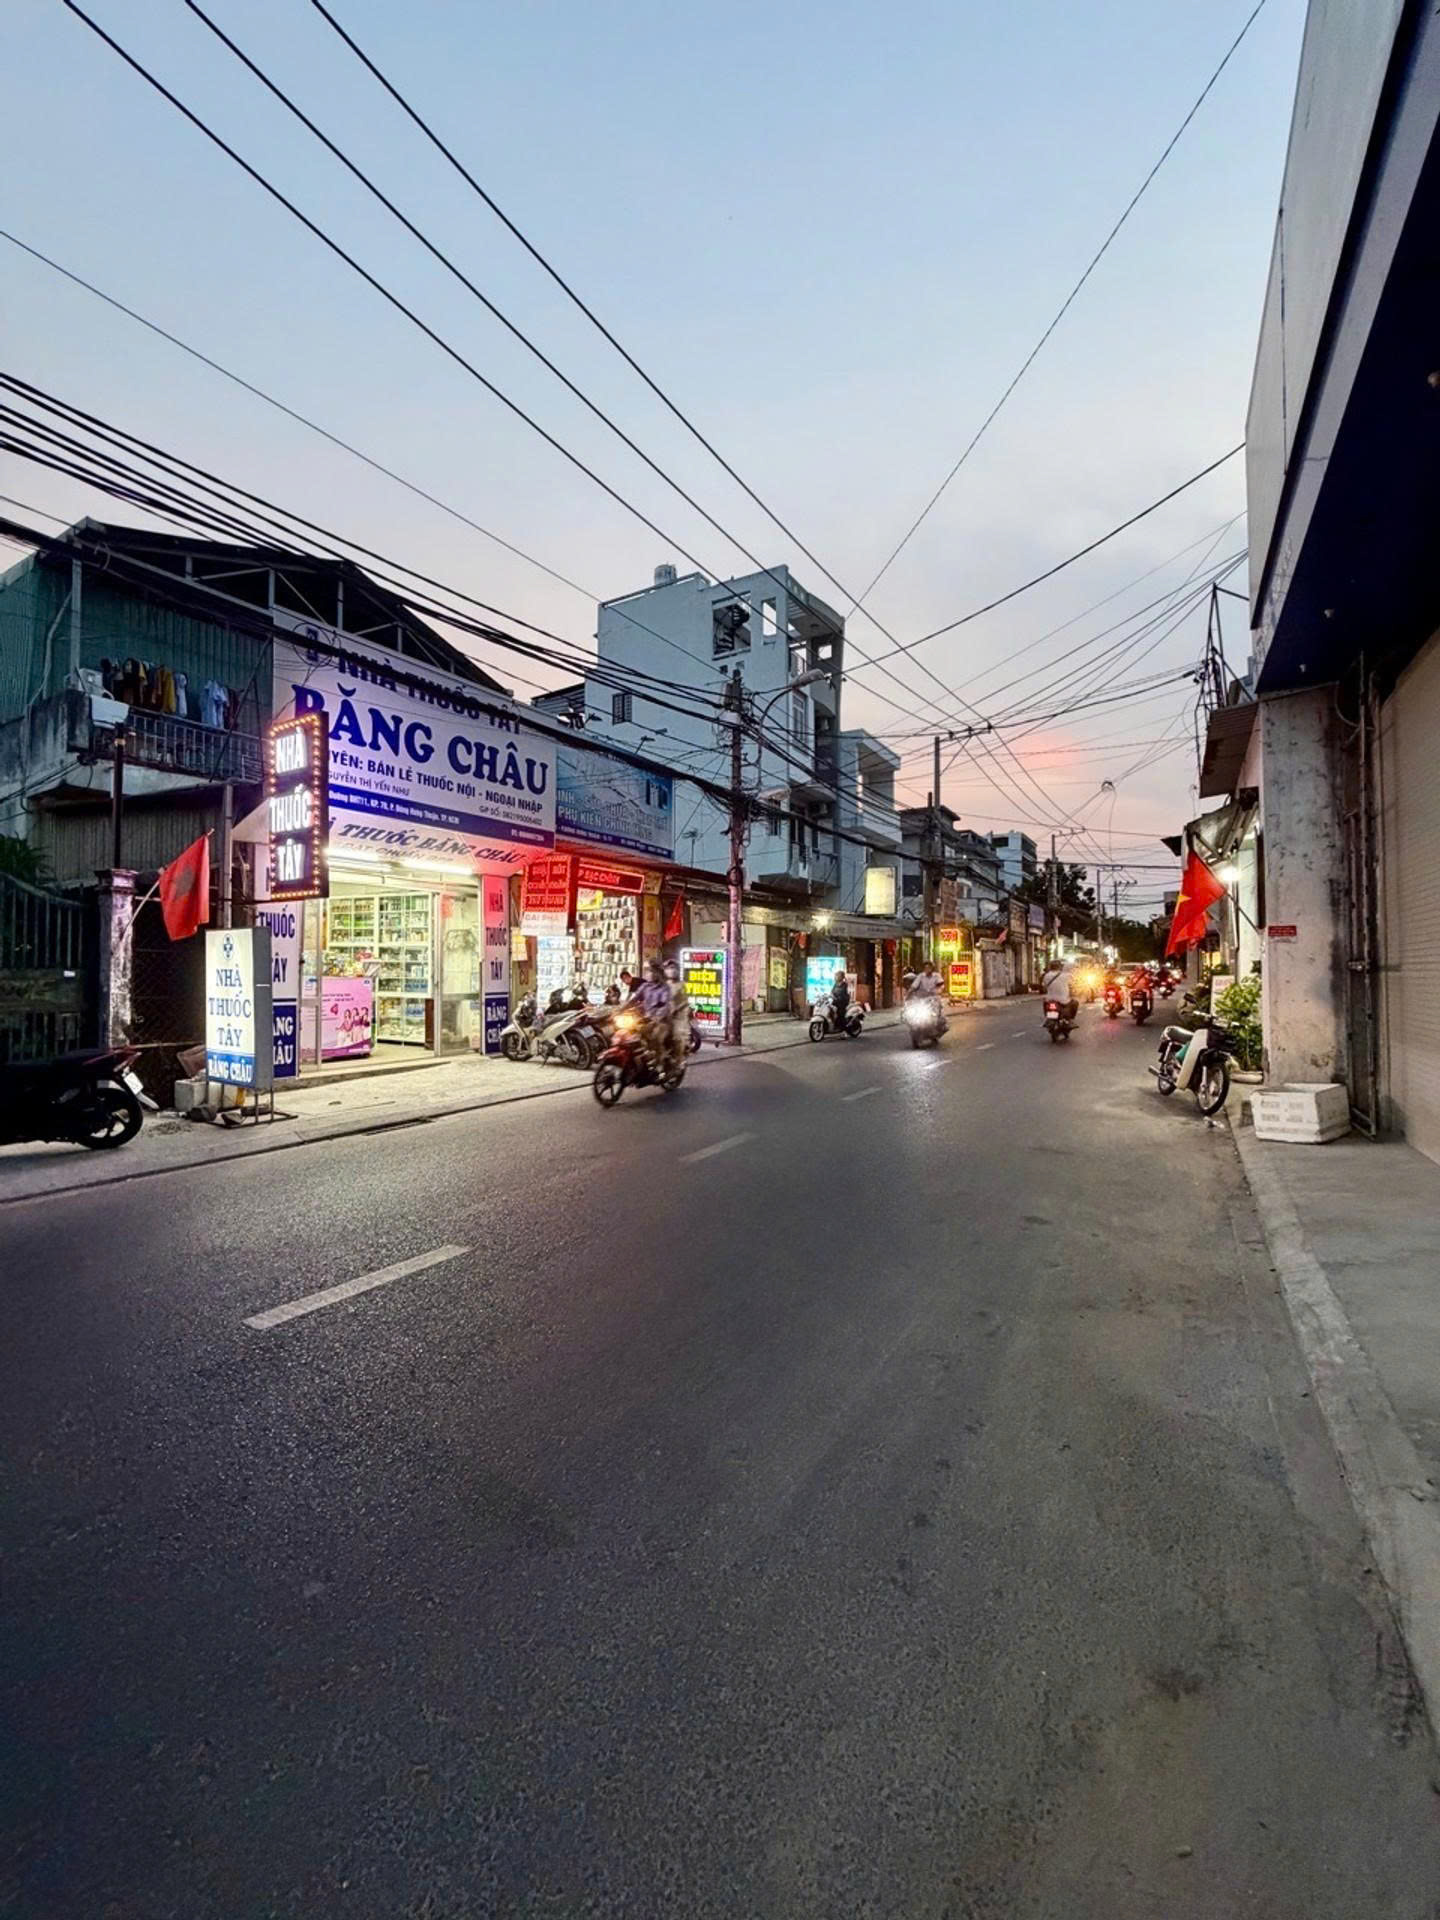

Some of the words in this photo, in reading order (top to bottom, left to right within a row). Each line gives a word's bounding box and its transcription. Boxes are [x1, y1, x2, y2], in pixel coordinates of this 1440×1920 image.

[276, 727, 308, 773] NHÀ
[291, 683, 434, 764] BĂNG
[446, 735, 549, 795] CHÂU
[328, 770, 357, 785] GUYỄN
[328, 750, 363, 770] YÊN:
[367, 759, 395, 778] BÁN
[416, 770, 454, 792] THUỐC
[457, 782, 475, 799] NỘI
[486, 790, 515, 809] NGOẠI
[517, 797, 543, 815] NHẬP
[270, 783, 312, 833] THUỐC
[338, 822, 420, 847] THUỐC
[475, 847, 527, 863] CHÂU
[277, 838, 305, 881] TÂY
[486, 920, 508, 946] THUỐC
[216, 963, 243, 987] NHÀ
[271, 952, 288, 982] ÂY
[490, 957, 504, 981] TÂY
[208, 990, 252, 1018] THUỐC
[217, 1023, 243, 1047] TÂY
[272, 1016, 293, 1037] NG
[272, 1039, 293, 1065] ÂU
[207, 1055, 229, 1079] BĂNG
[229, 1058, 252, 1083] CHÂU
